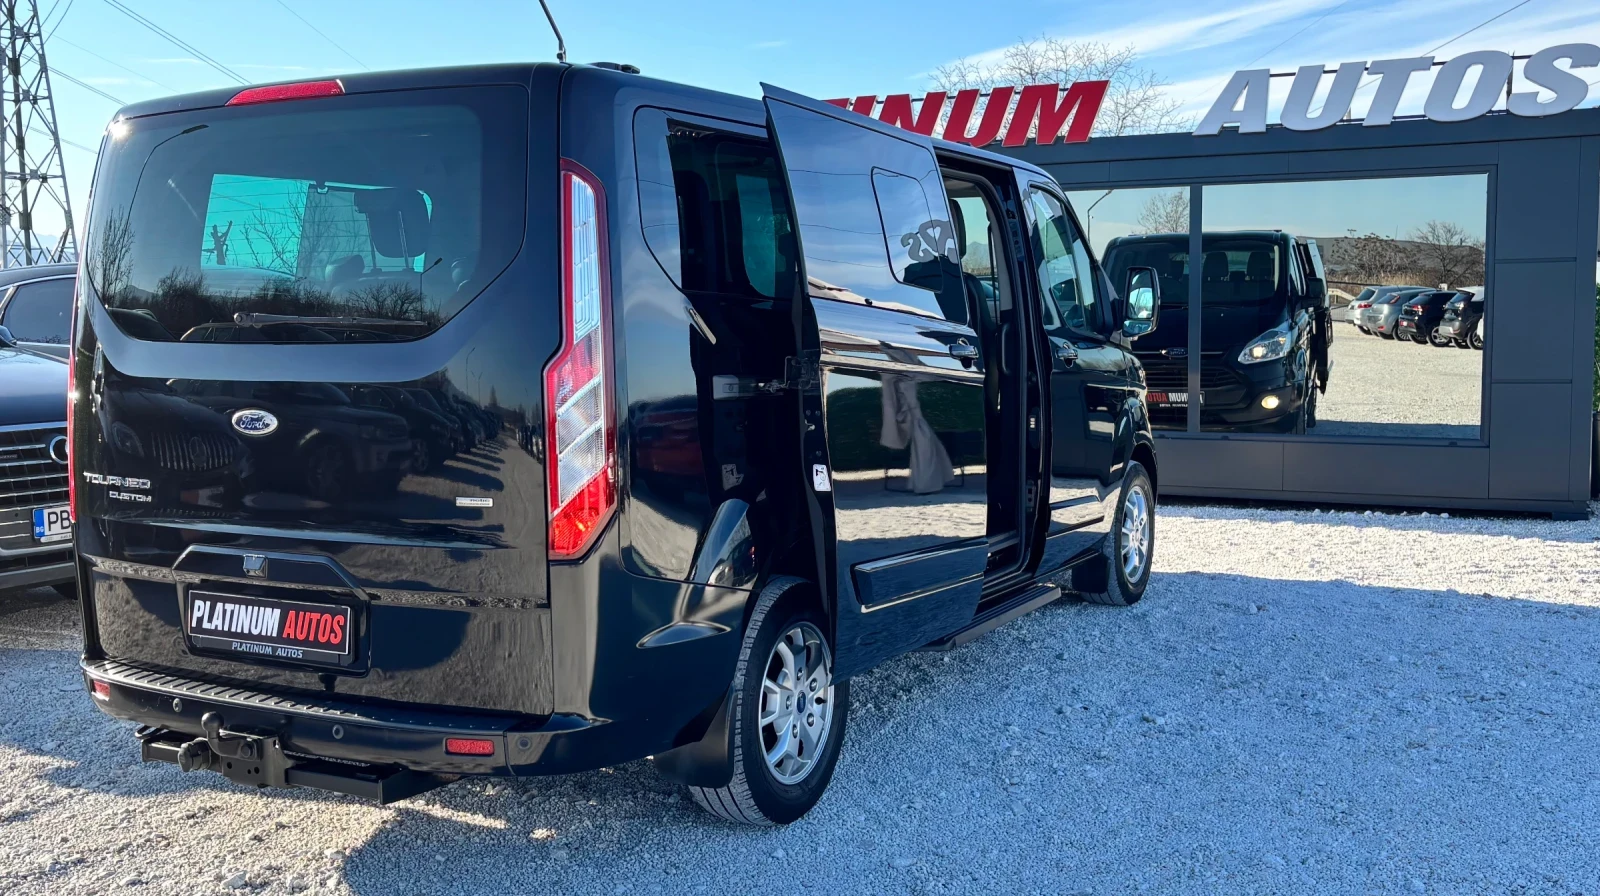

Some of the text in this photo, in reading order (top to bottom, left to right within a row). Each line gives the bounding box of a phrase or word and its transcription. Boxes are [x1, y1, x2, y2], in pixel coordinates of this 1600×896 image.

[1192, 43, 1600, 136] AUTOS
[83, 471, 151, 489] TOURNEO
[109, 490, 152, 502] CUSTOM
[192, 600, 345, 645] PLATINUM AUTOS
[231, 642, 304, 659] PLATINUM AUTOS
